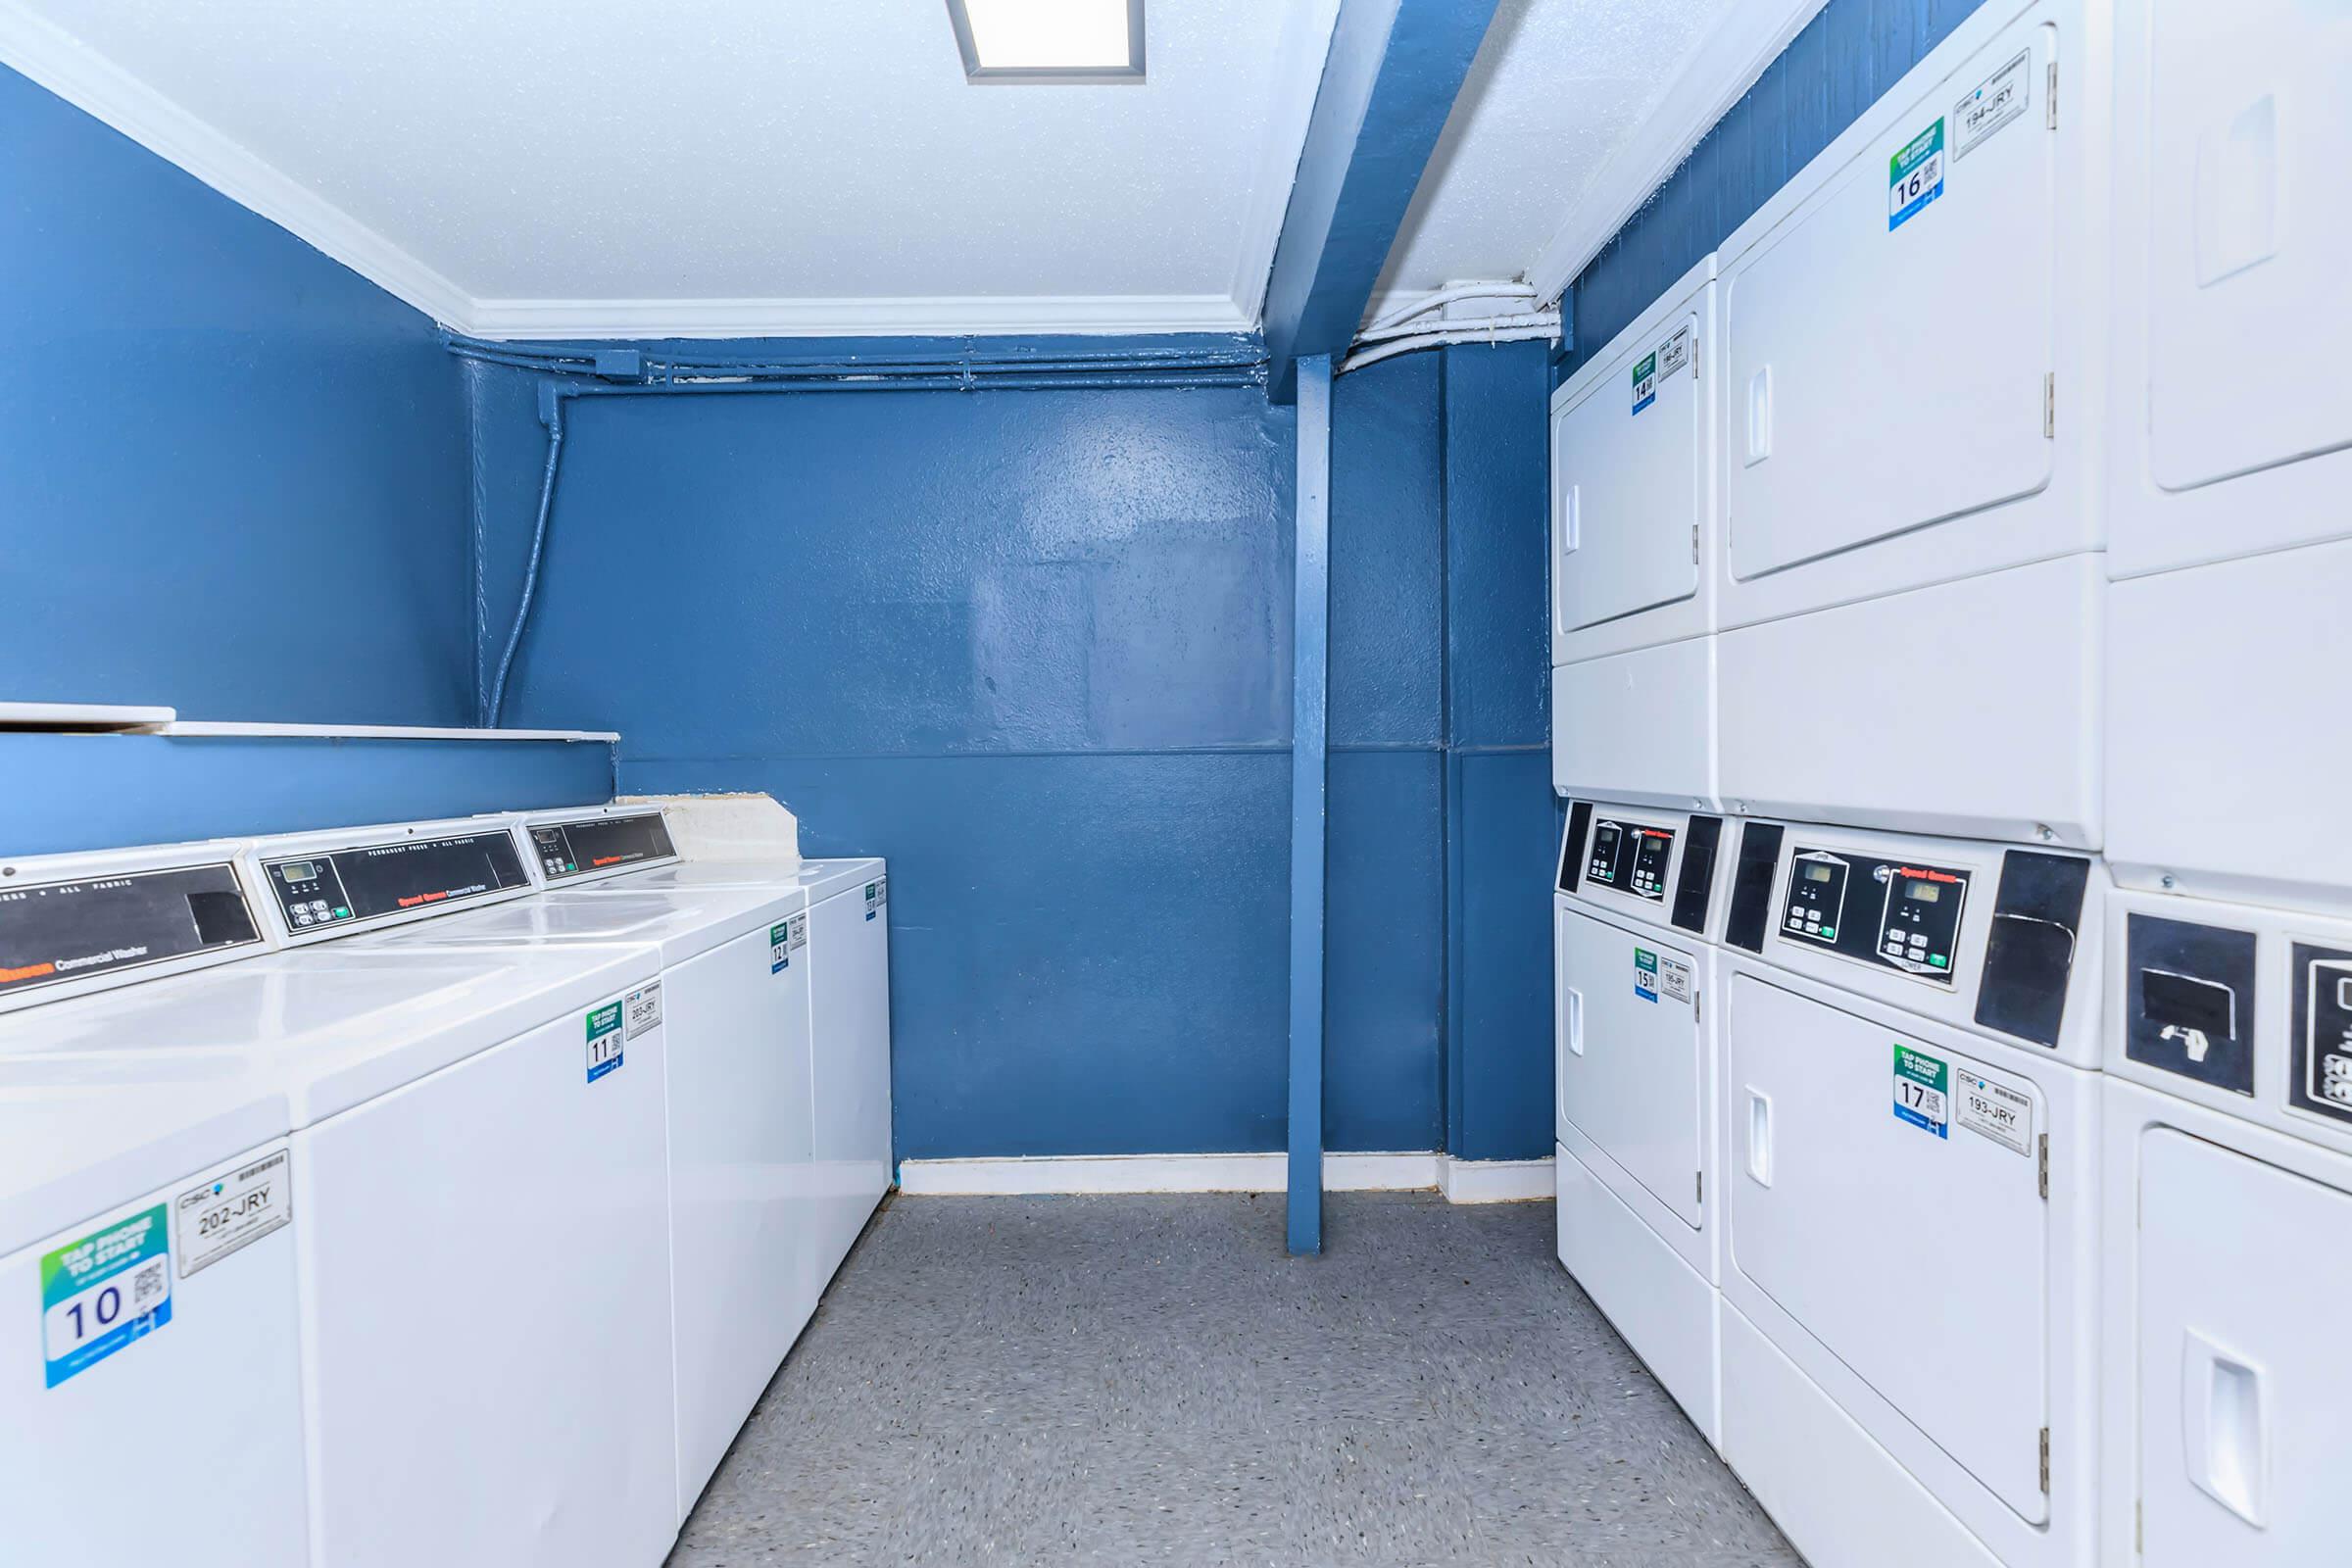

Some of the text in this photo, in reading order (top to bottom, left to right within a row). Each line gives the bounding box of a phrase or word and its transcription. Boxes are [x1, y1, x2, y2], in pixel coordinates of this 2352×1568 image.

[1966, 84, 2014, 129] 194-JRY
[1897, 172, 1921, 205] 16
[1636, 381, 1646, 401] 14
[773, 947, 782, 961] 12
[1639, 971, 1648, 987] 15
[593, 1039, 608, 1062] 11
[1901, 1052, 1940, 1072] TAP PHONE
[1903, 1060, 1915, 1071] TO
[1914, 1063, 1937, 1079] START
[1901, 1083, 1924, 1108] 17
[1970, 1096, 2015, 1126] 193-JRY
[199, 1186, 270, 1235] 202-JRY
[60, 1215, 154, 1266] TAP PHONE
[69, 1258, 95, 1279] TO
[93, 1232, 147, 1267] START
[66, 1287, 122, 1341] 10
